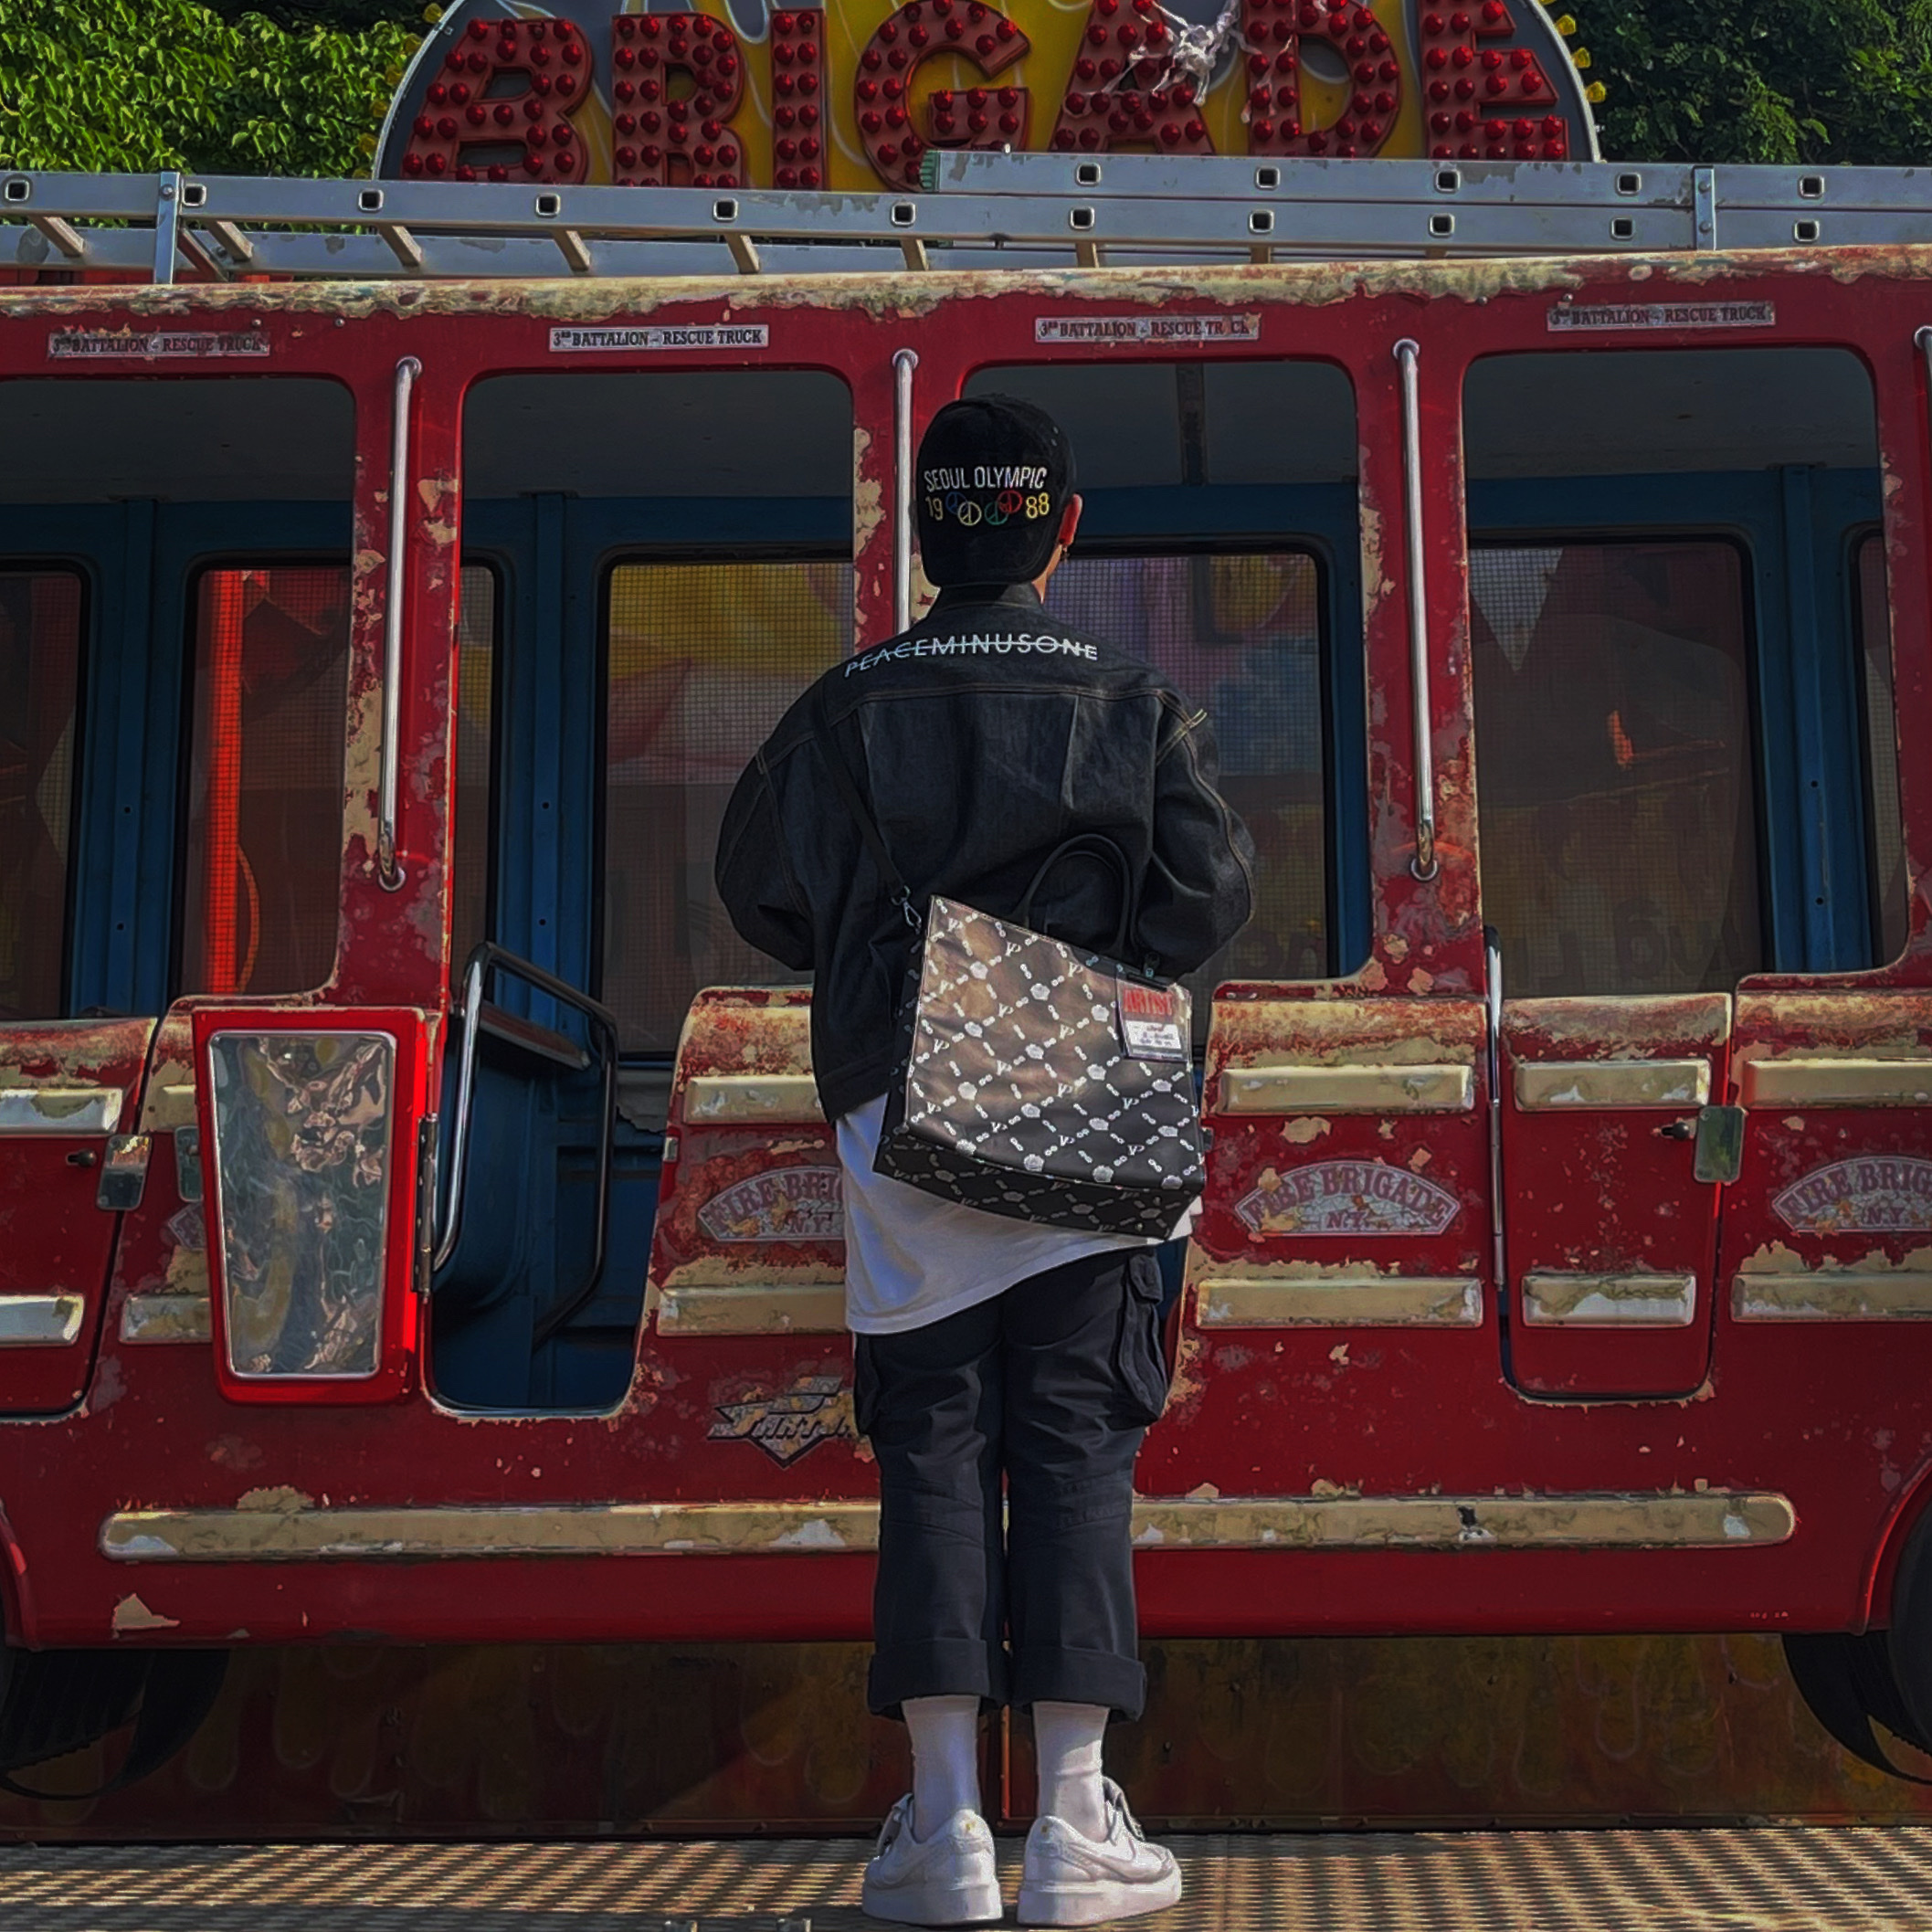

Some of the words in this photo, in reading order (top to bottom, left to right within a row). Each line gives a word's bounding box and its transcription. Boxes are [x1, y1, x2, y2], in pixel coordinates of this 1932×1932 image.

[399, 0, 1569, 193] BRIGADE
[1572, 308, 1650, 324] BATTALION
[1664, 307, 1717, 322] RESCUE
[1719, 305, 1766, 321] TRUCK
[572, 331, 649, 346] BATTALION
[662, 330, 713, 345] RESCUE
[717, 329, 762, 343] TRUCK
[1060, 322, 1135, 336] BATTALION
[1151, 322, 1201, 336] RESCUE
[1205, 321, 1250, 335] TRCK
[72, 337, 149, 353] BATTALION
[163, 337, 214, 352] RESCUE
[219, 334, 263, 351] TRUCK
[924, 467, 970, 492] SEOUL
[974, 466, 1048, 489] OLYMPIC
[924, 496, 944, 521] 19
[1026, 492, 1050, 518] 88
[844, 633, 1098, 678] PEACEMINUSONE
[1320, 1167, 1452, 1226] BRIGADE
